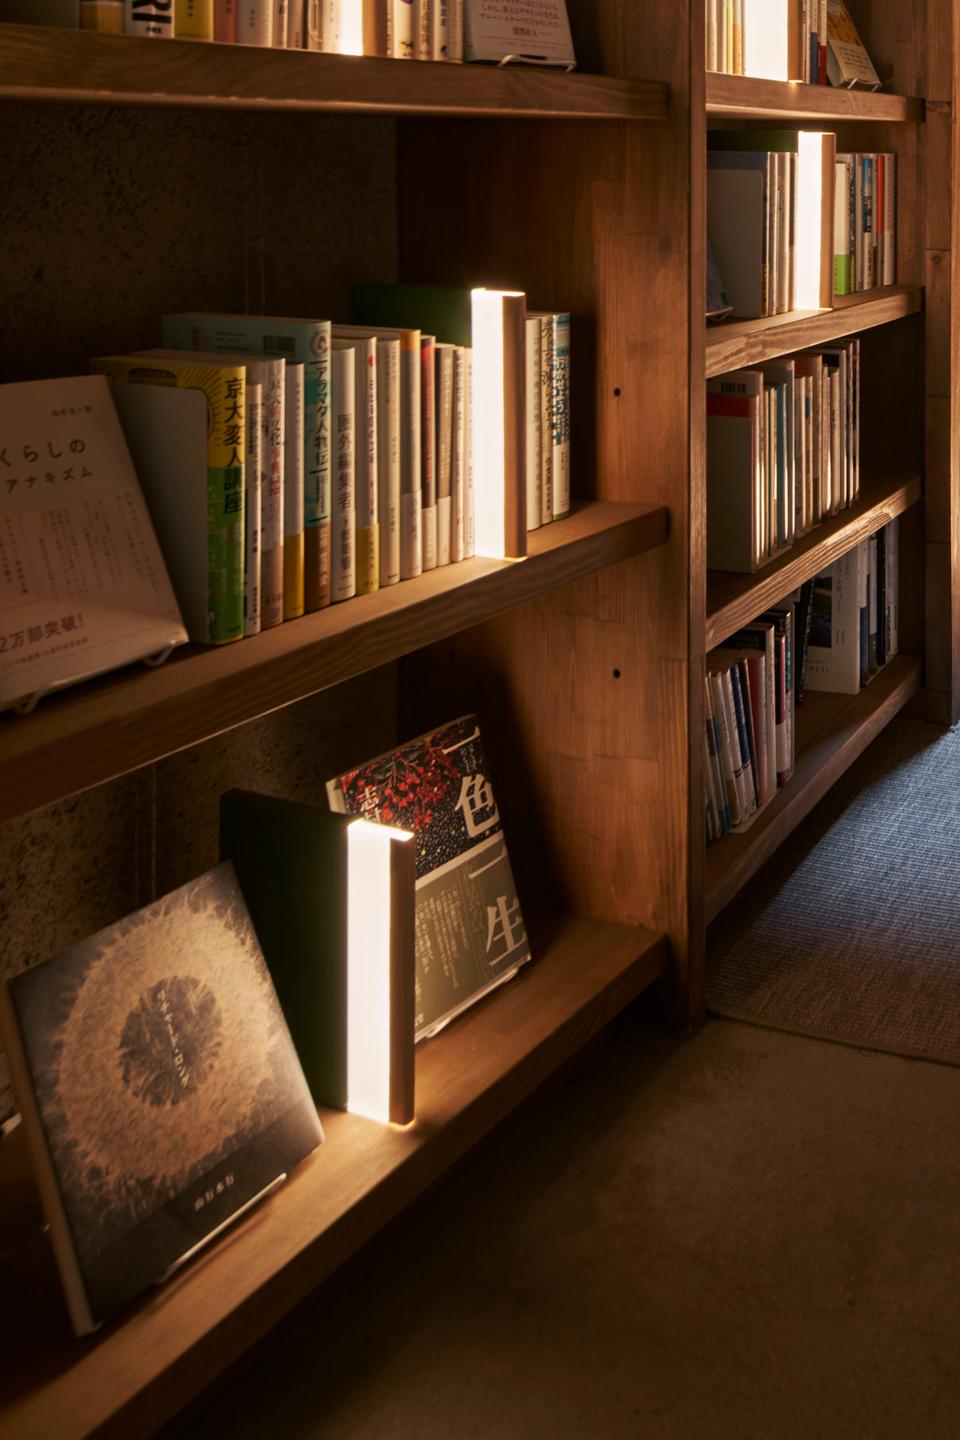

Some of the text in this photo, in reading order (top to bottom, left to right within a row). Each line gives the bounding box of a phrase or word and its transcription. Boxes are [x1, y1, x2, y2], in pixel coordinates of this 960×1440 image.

[0, 439, 86, 467] くらしの
[4, 465, 93, 494] アナキズム
[223, 376, 244, 514] 京大変人講座
[442, 725, 528, 967] 一色一生
